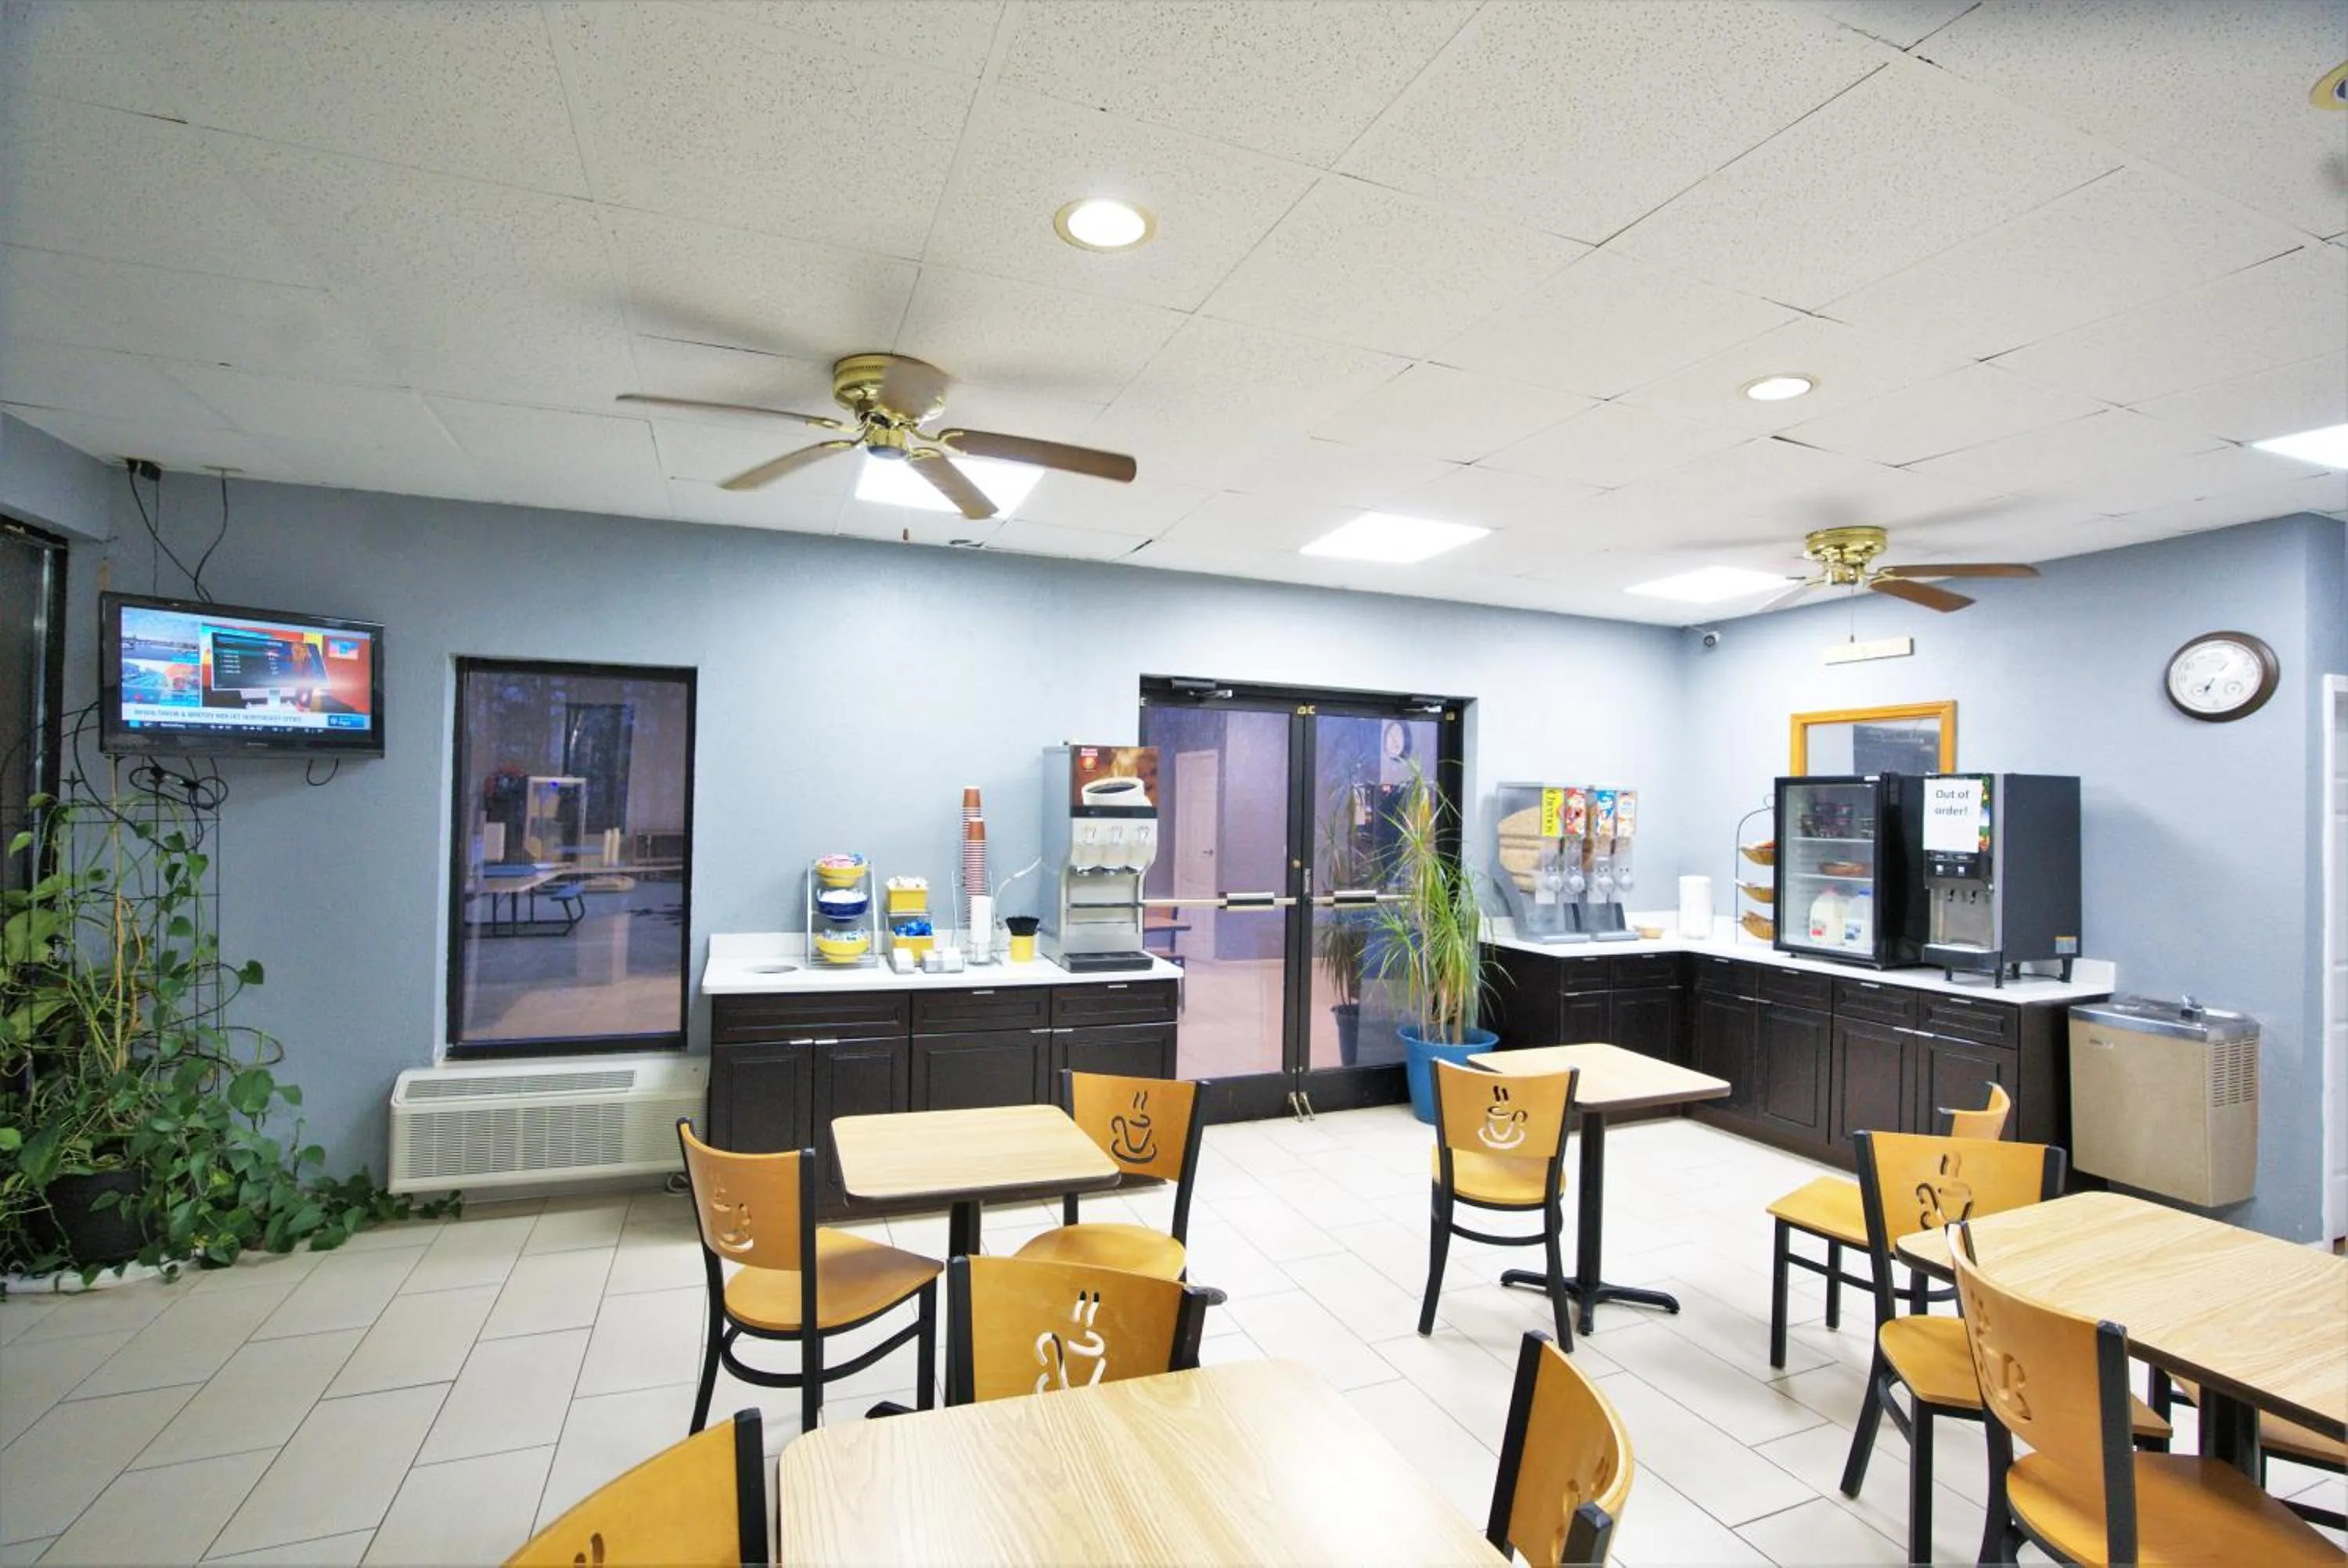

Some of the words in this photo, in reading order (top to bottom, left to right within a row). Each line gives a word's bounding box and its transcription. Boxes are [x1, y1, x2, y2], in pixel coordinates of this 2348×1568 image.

[1936, 789, 1954, 799] Out
[1957, 789, 1970, 799] of
[1935, 805, 1968, 816] order!
